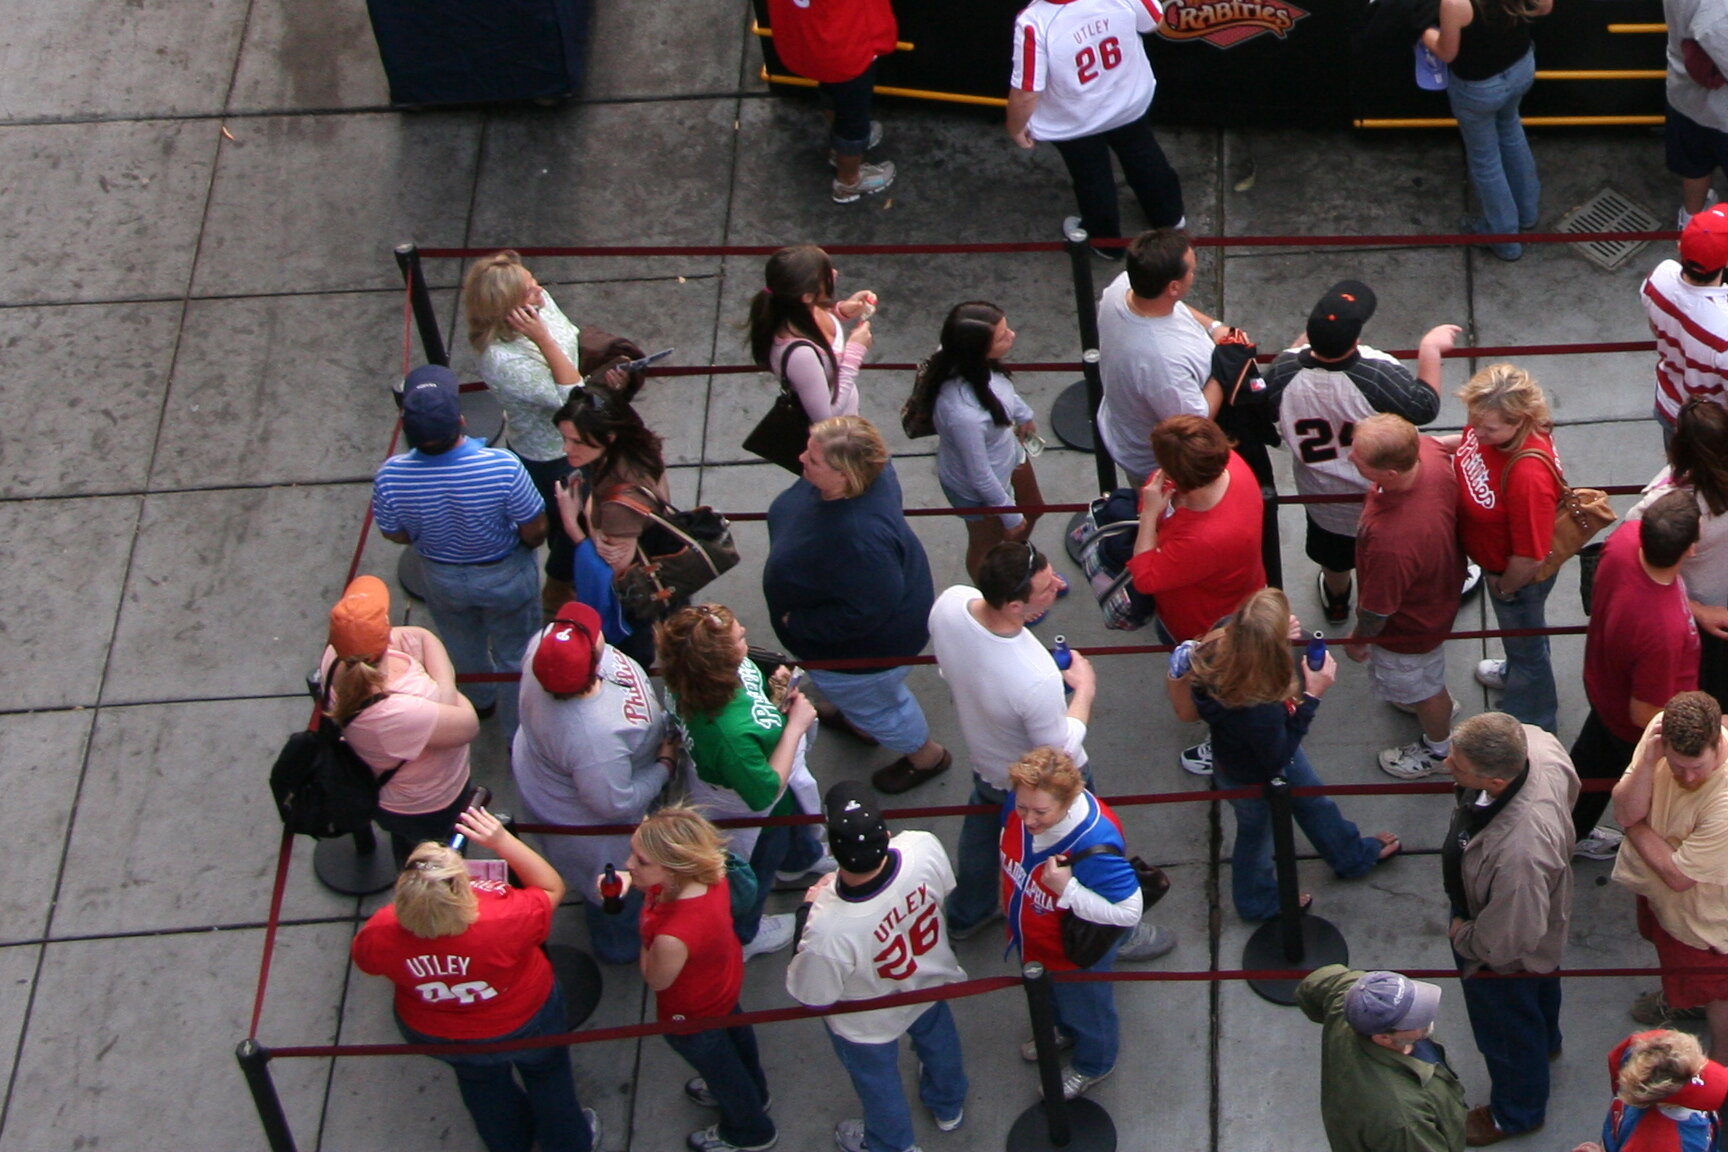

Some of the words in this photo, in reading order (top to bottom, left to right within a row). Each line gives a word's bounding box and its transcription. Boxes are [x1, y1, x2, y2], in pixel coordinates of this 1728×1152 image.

[1072, 17, 1110, 45] UTLEY
[1074, 35, 1123, 86] 26
[873, 882, 930, 944] UTLEY
[405, 955, 470, 978] UTLEY
[872, 902, 939, 981] 26
